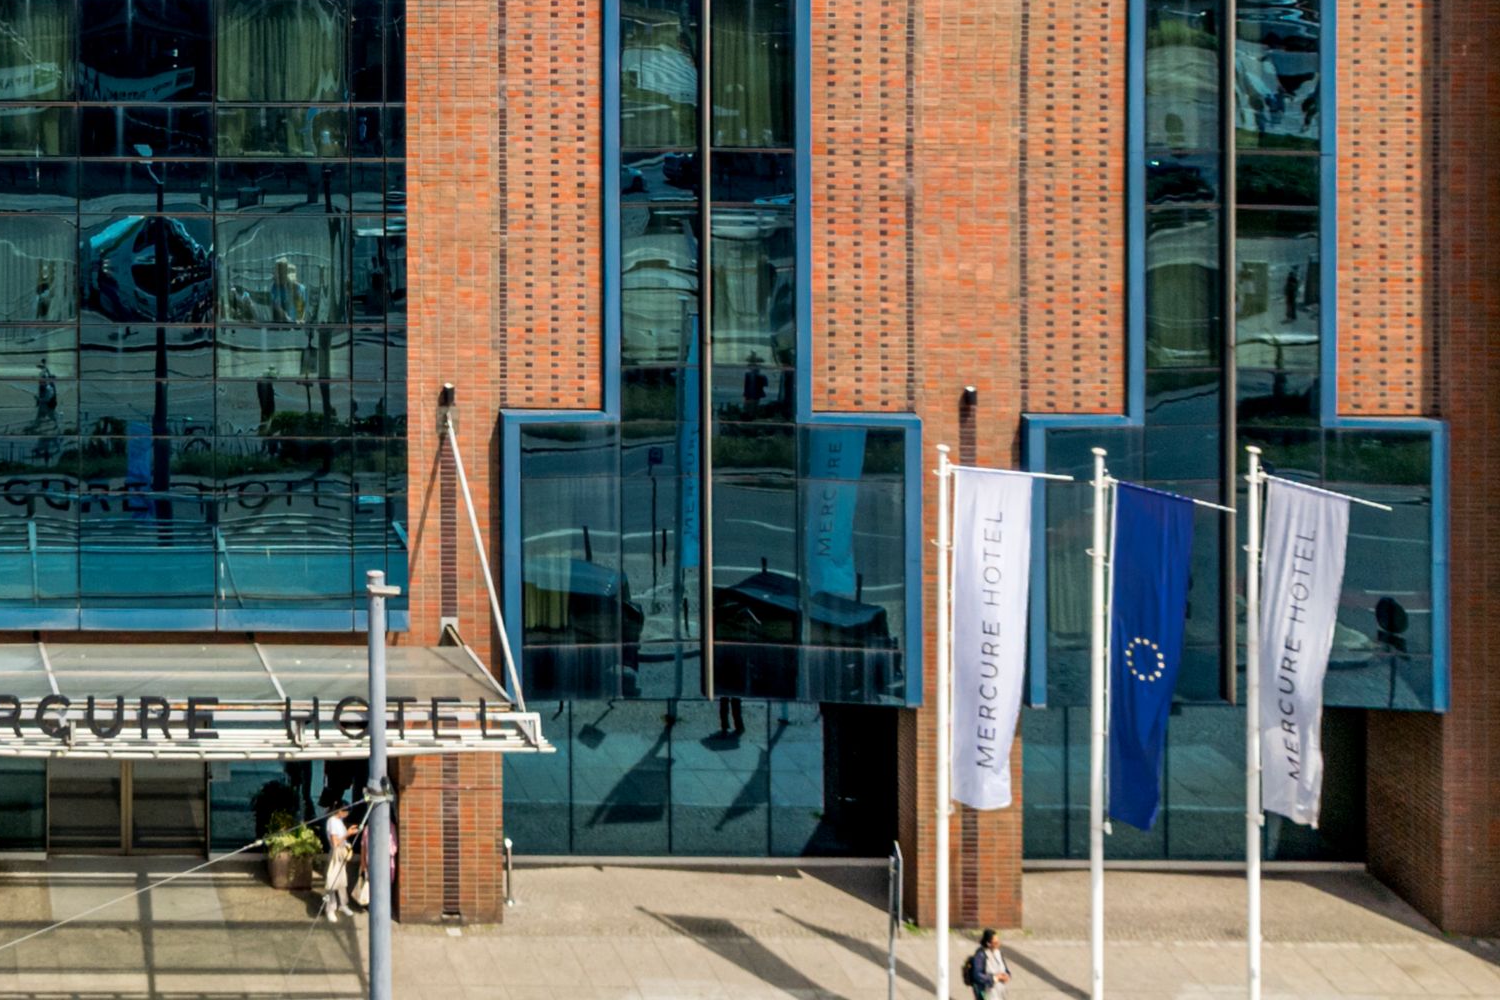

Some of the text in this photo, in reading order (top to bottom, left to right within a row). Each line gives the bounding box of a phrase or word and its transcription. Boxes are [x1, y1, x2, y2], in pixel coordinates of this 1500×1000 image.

[285, 695, 507, 740] HOTEL
[976, 511, 1003, 769] MERCURE HOTEL
[1278, 529, 1317, 781] MERCURE HOTEL
